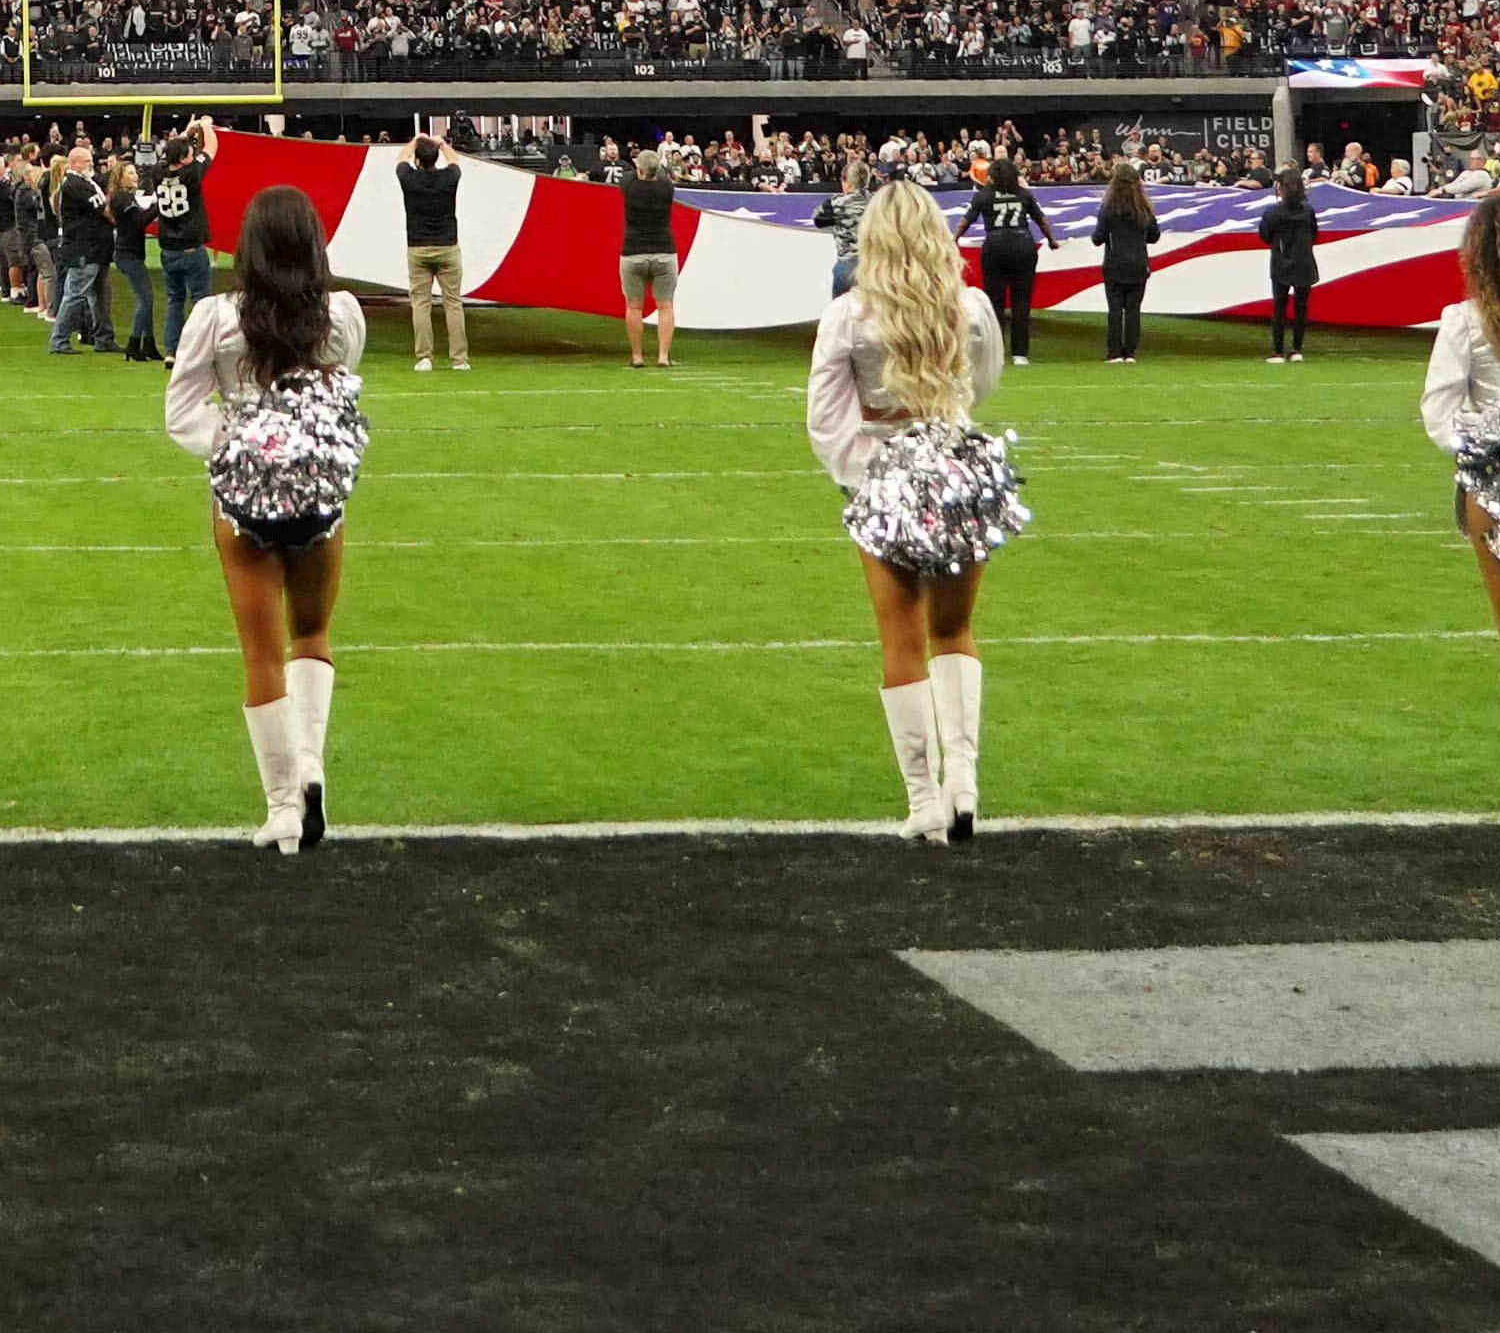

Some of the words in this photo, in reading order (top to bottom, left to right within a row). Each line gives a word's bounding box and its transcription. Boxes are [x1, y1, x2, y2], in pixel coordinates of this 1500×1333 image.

[98, 67, 116, 77] 101
[634, 64, 655, 75] 102
[1042, 63, 1063, 74] 103
[1213, 116, 1273, 131] FIELD
[1216, 134, 1270, 148] CLUB
[993, 202, 1022, 227] 77
